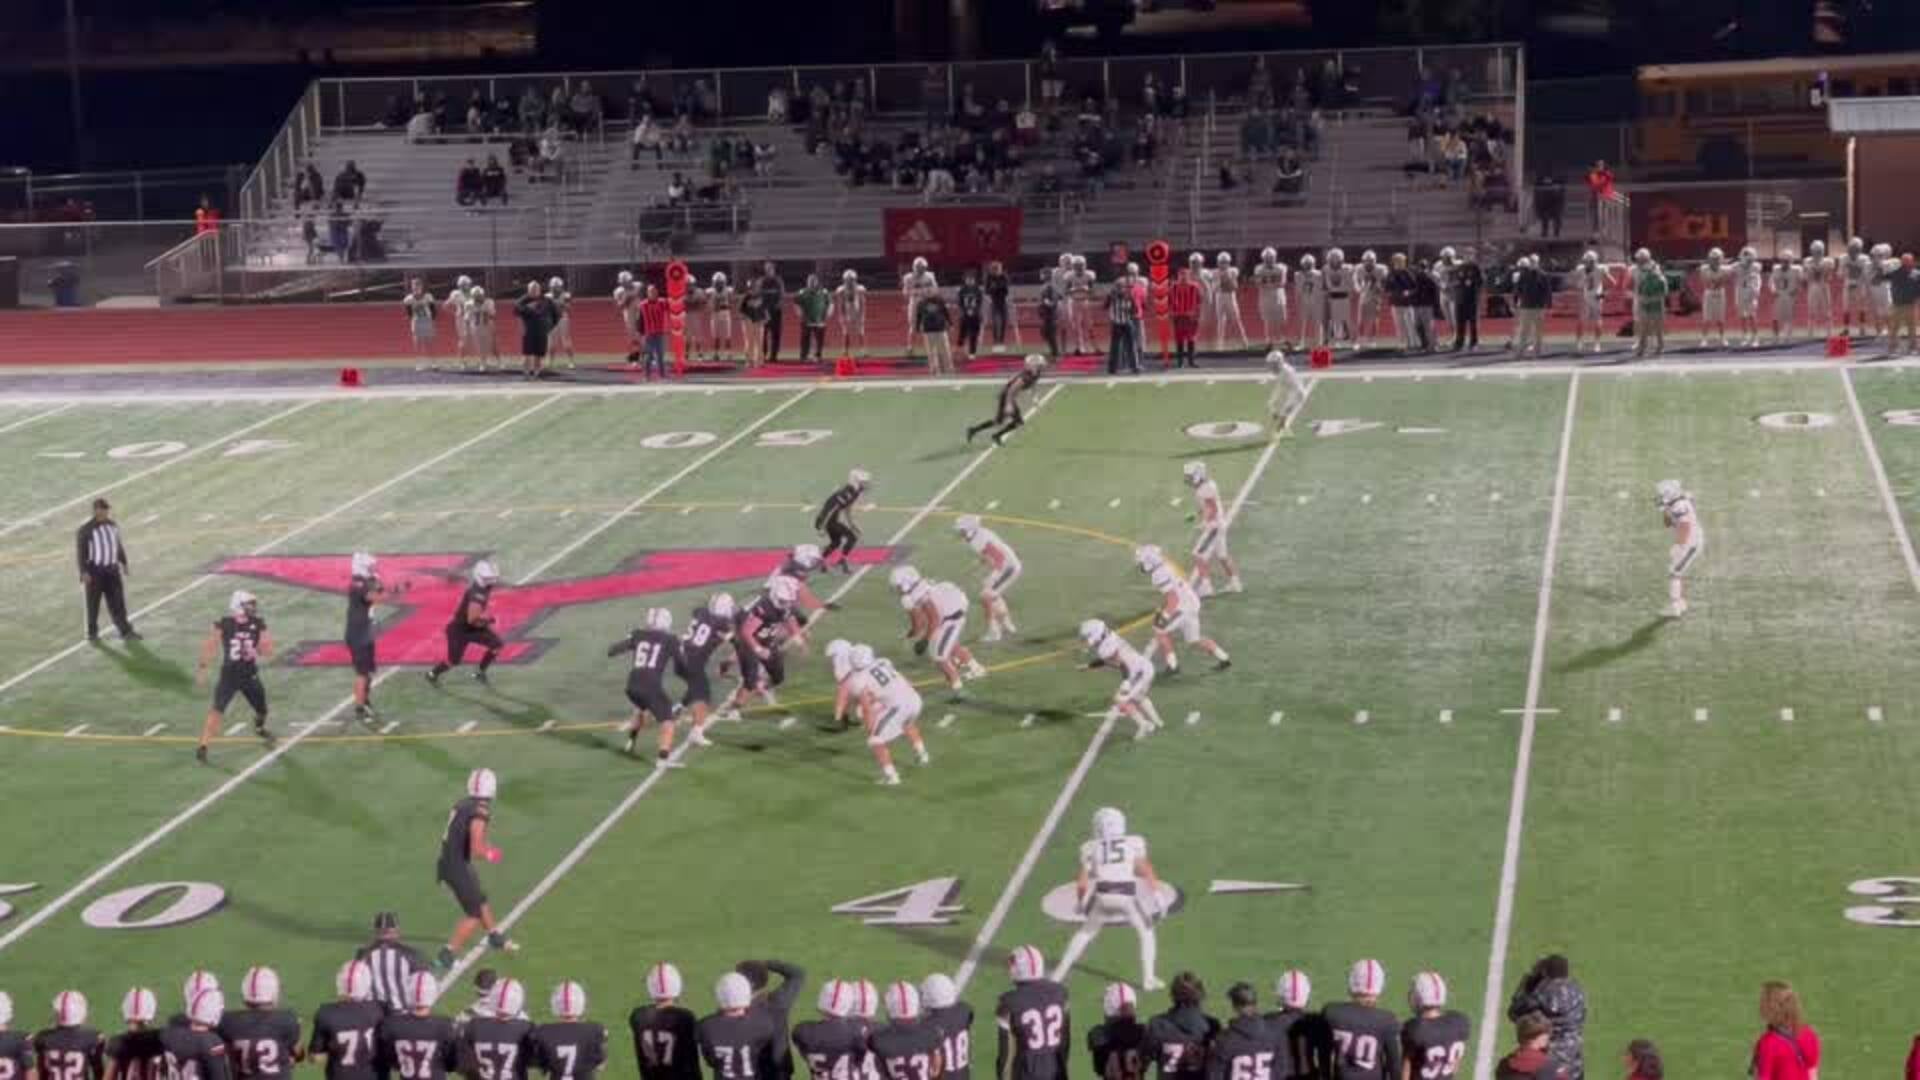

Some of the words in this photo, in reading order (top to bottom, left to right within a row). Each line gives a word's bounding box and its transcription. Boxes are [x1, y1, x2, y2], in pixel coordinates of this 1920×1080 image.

[634, 641, 661, 668] 61
[1099, 839, 1125, 865] 15
[1021, 1005, 1063, 1049] 32
[45, 1050, 86, 1080] 52
[233, 1039, 280, 1075] 72
[393, 1040, 437, 1079] 67
[473, 1043, 518, 1080] 57
[555, 1045, 577, 1080] 7
[713, 1045, 754, 1078] 71
[942, 1030, 968, 1072] 18
[1231, 1052, 1274, 1080] 65
[1331, 1030, 1377, 1070] 70
